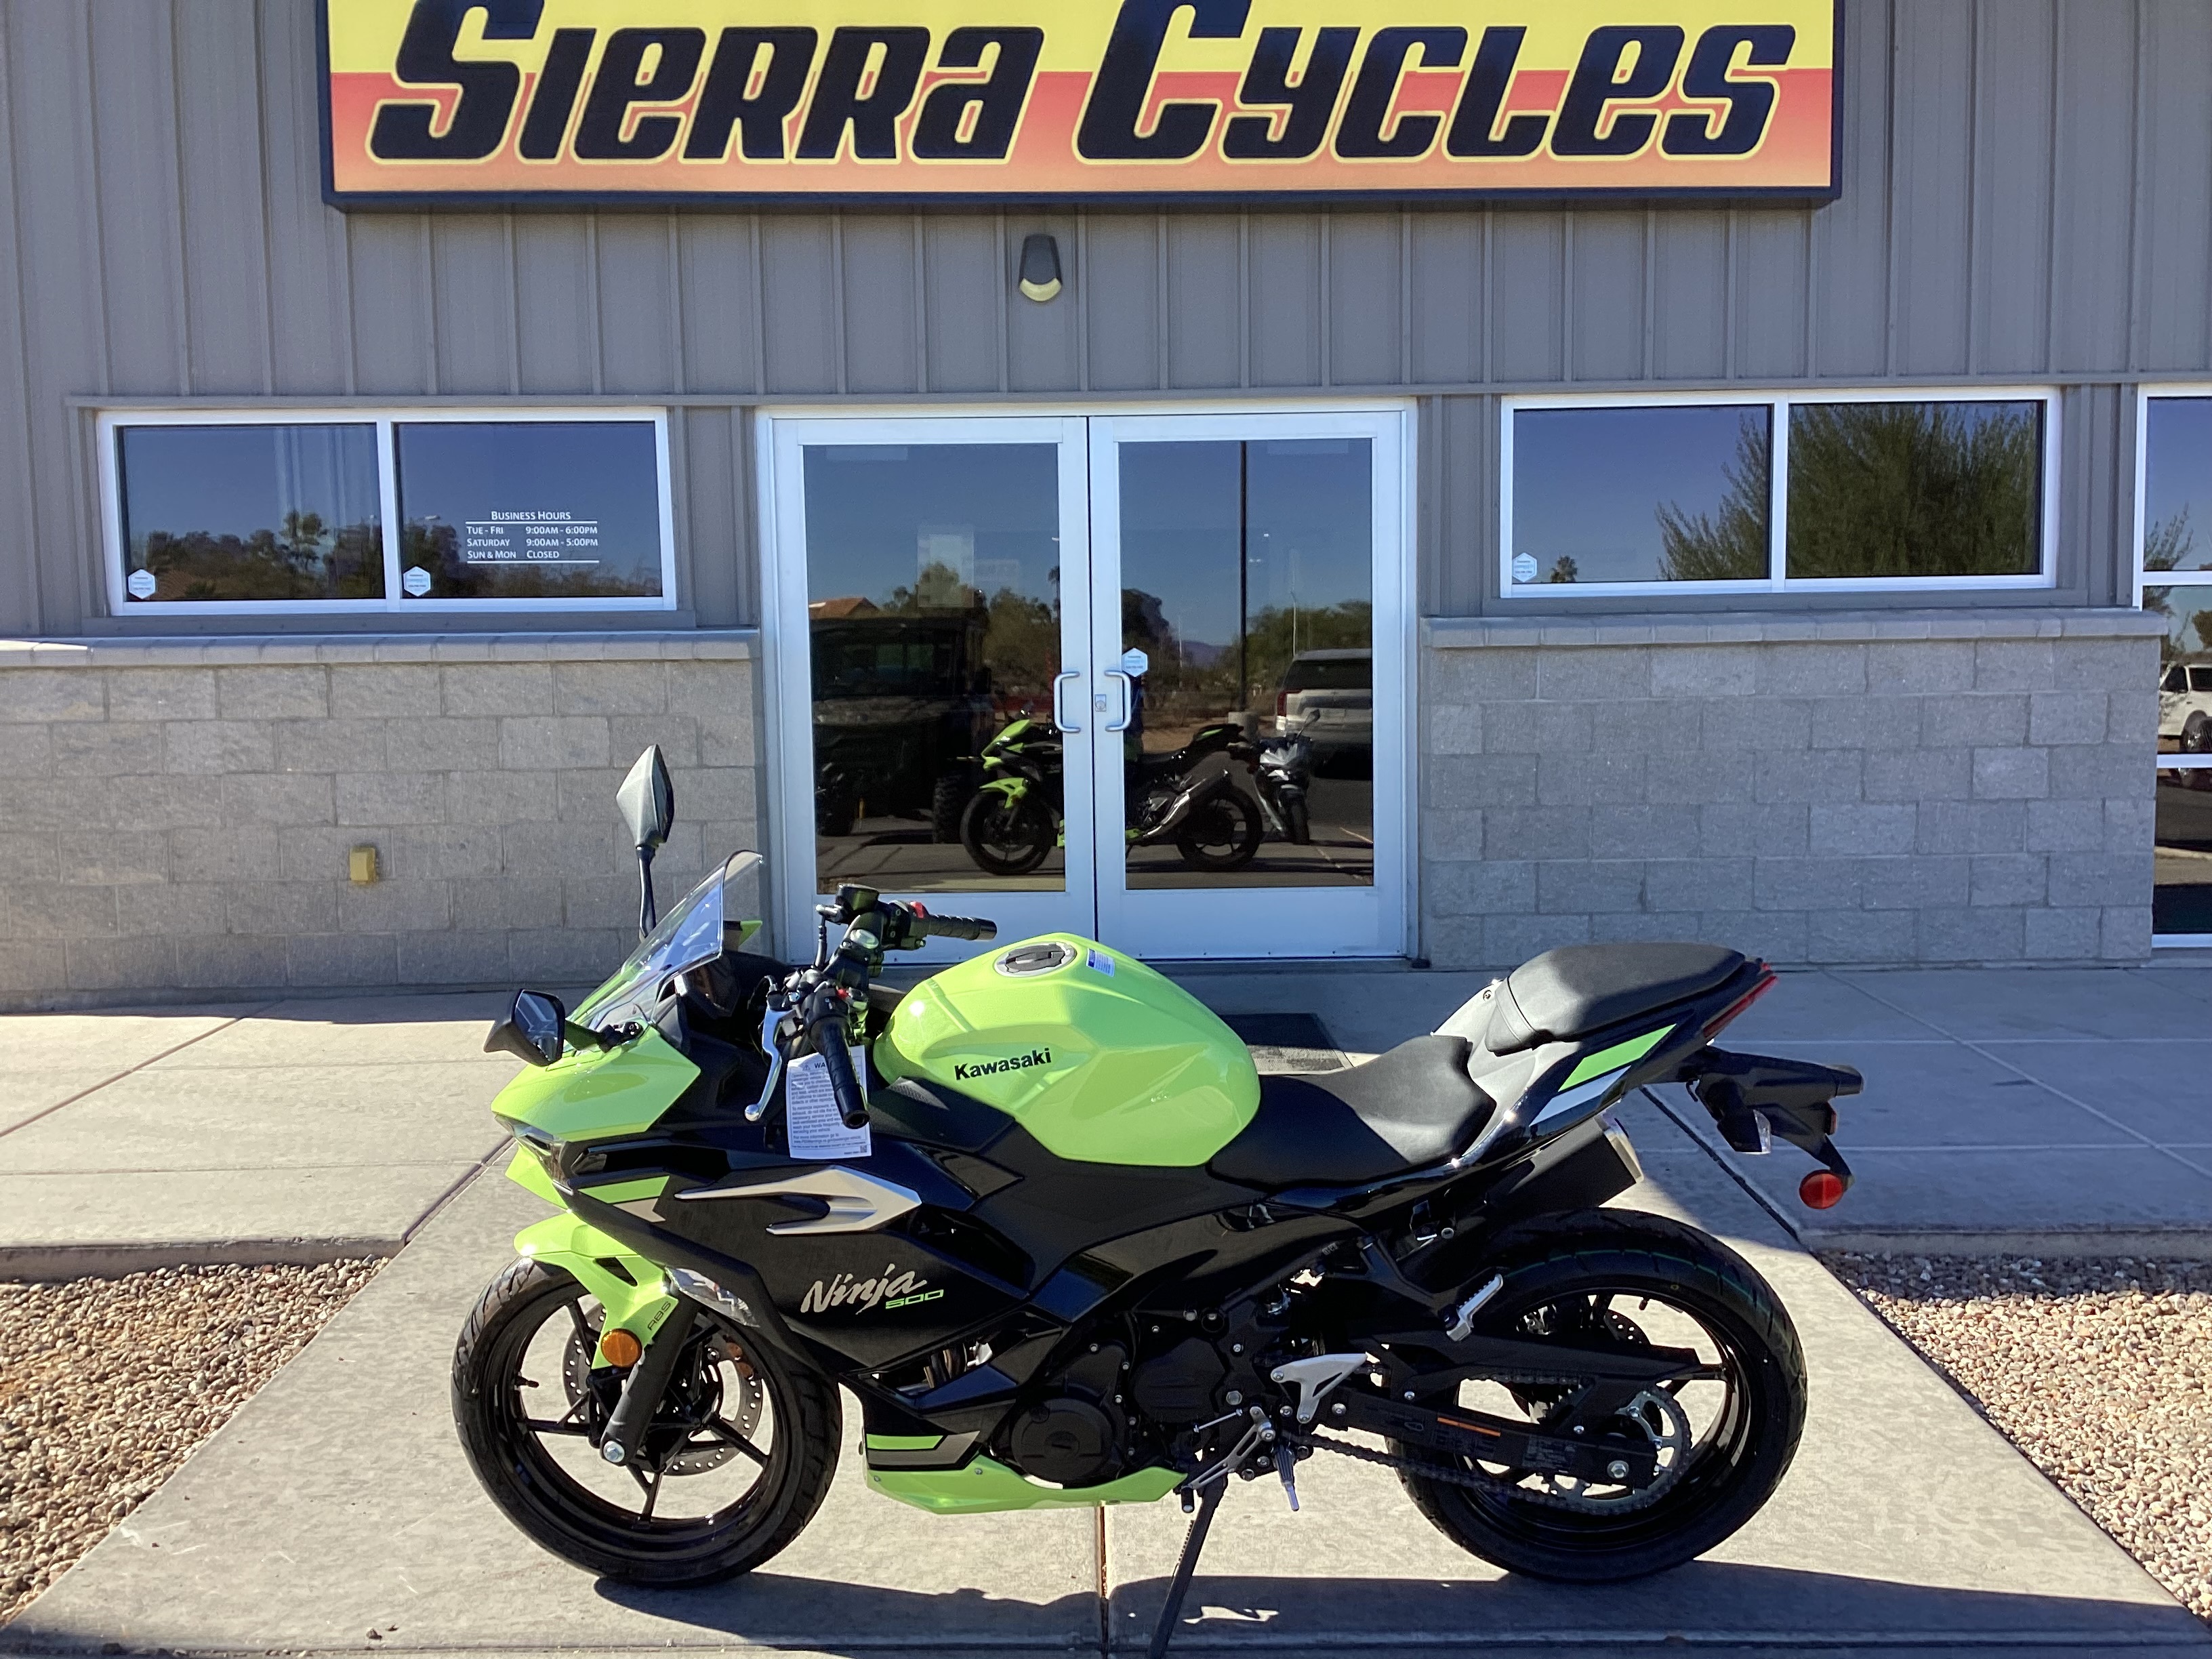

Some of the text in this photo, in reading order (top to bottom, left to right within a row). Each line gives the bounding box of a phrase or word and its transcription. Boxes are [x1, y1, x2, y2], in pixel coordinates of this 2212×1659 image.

[1076, 0, 1797, 161] Cycles
[491, 511, 571, 520] BUSINESS HOURS
[466, 526, 483, 535] TUE
[490, 526, 504, 534] FRI
[525, 526, 558, 534] 9:00AM
[565, 526, 598, 534] 6:00PM
[466, 538, 510, 547] SATURDAY
[526, 538, 559, 546] 9:00AM
[566, 538, 598, 546] 5:00PM
[467, 550, 560, 559] SUN & MON CLOSED
[954, 1047, 1052, 1081] Kawasaki
[800, 1263, 928, 1315] Ninja
[885, 1289, 944, 1309] 500
[647, 1300, 672, 1332] ABS
